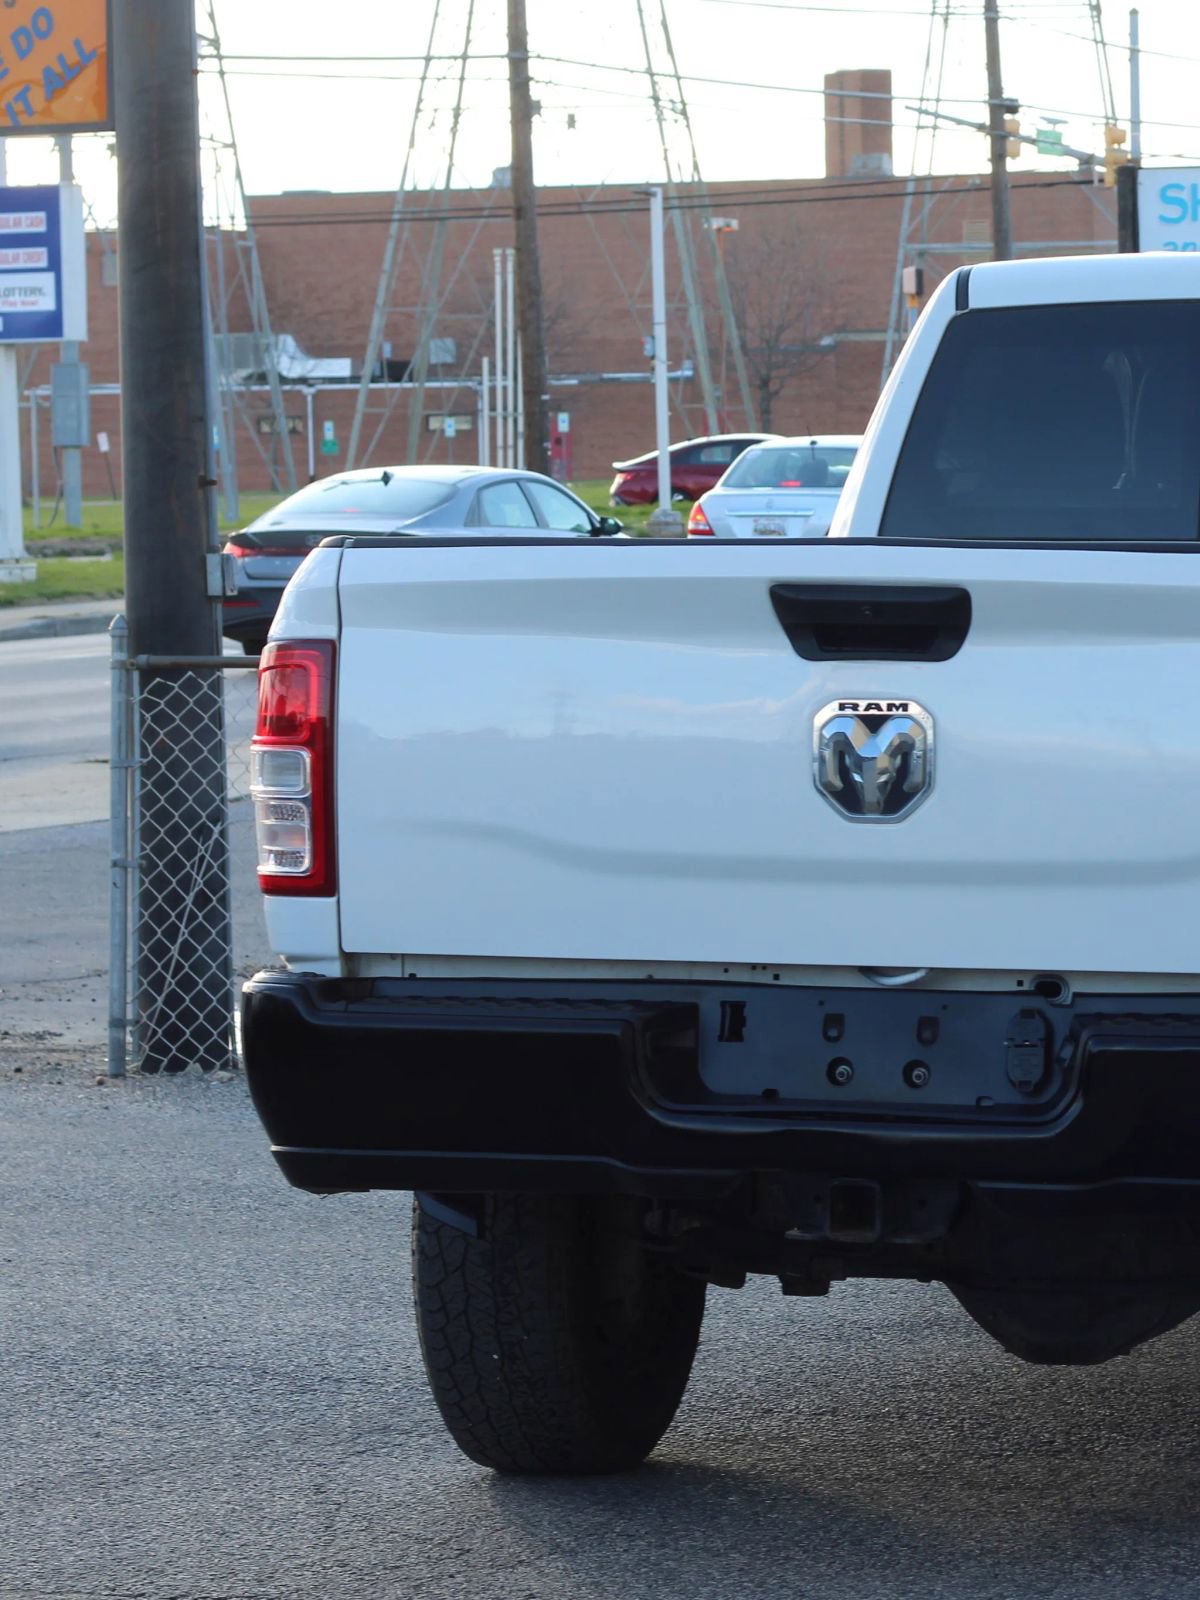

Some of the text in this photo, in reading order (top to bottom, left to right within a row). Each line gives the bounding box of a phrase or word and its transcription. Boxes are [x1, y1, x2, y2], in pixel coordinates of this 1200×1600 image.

[11, 7, 53, 60] DO
[5, 84, 33, 127] IT
[42, 38, 97, 102] ALL
[838, 702, 910, 712] RAM
